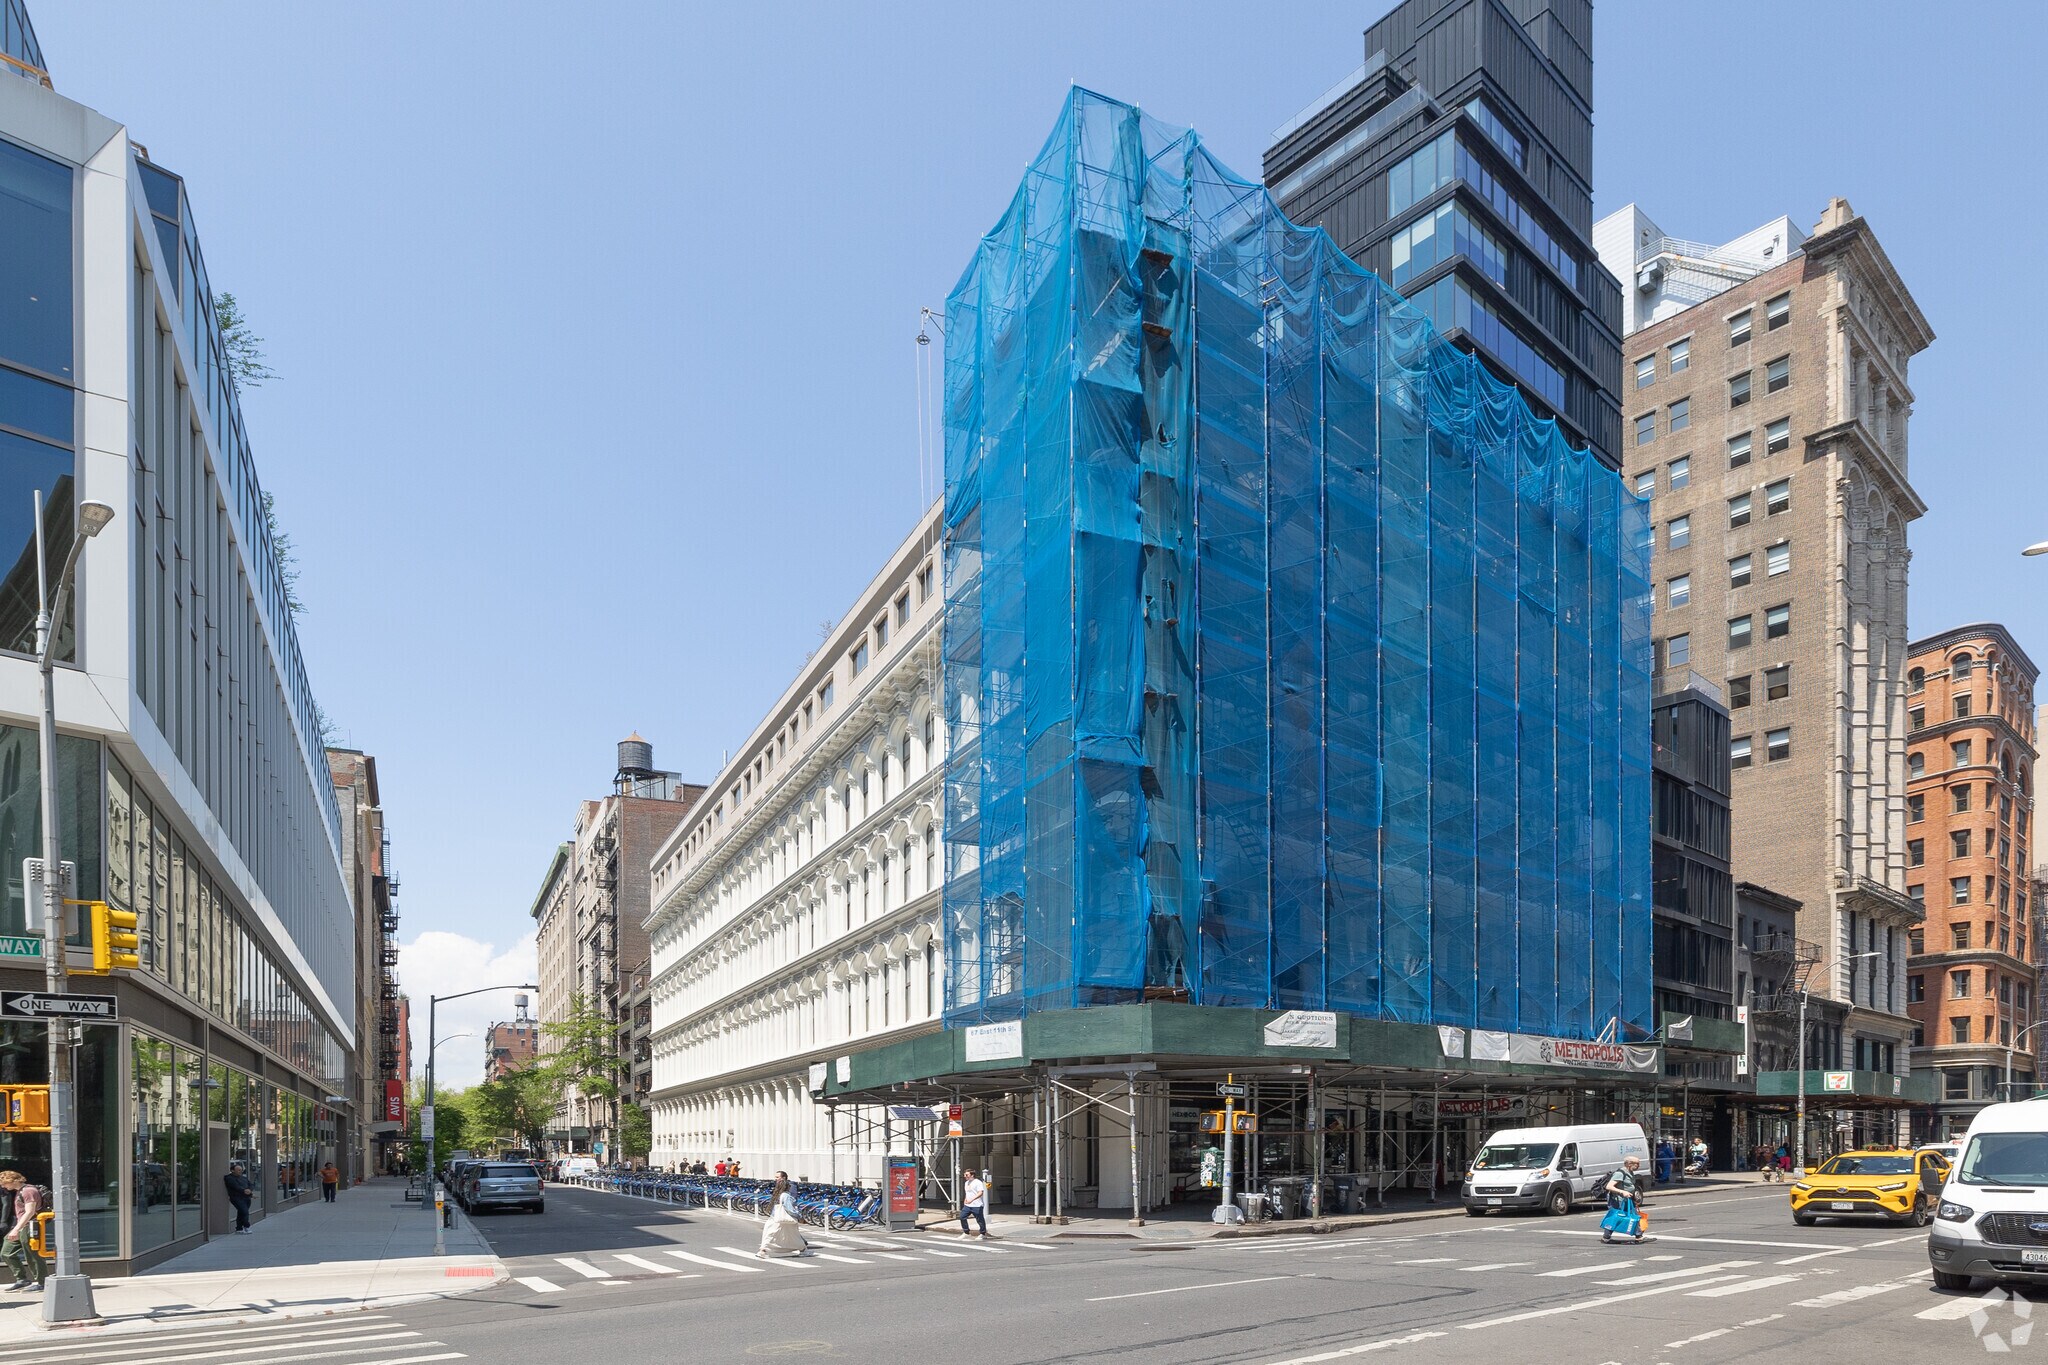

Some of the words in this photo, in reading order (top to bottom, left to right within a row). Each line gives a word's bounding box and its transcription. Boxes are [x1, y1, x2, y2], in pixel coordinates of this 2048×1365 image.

[20, 1000, 52, 1010] ONE
[68, 1002, 101, 1012] WAY
[980, 1027, 993, 1035] East
[1554, 1042, 1625, 1062] METROPOLIS
[1563, 1059, 1588, 1067] VINTAGE
[390, 1096, 400, 1116] AVIS
